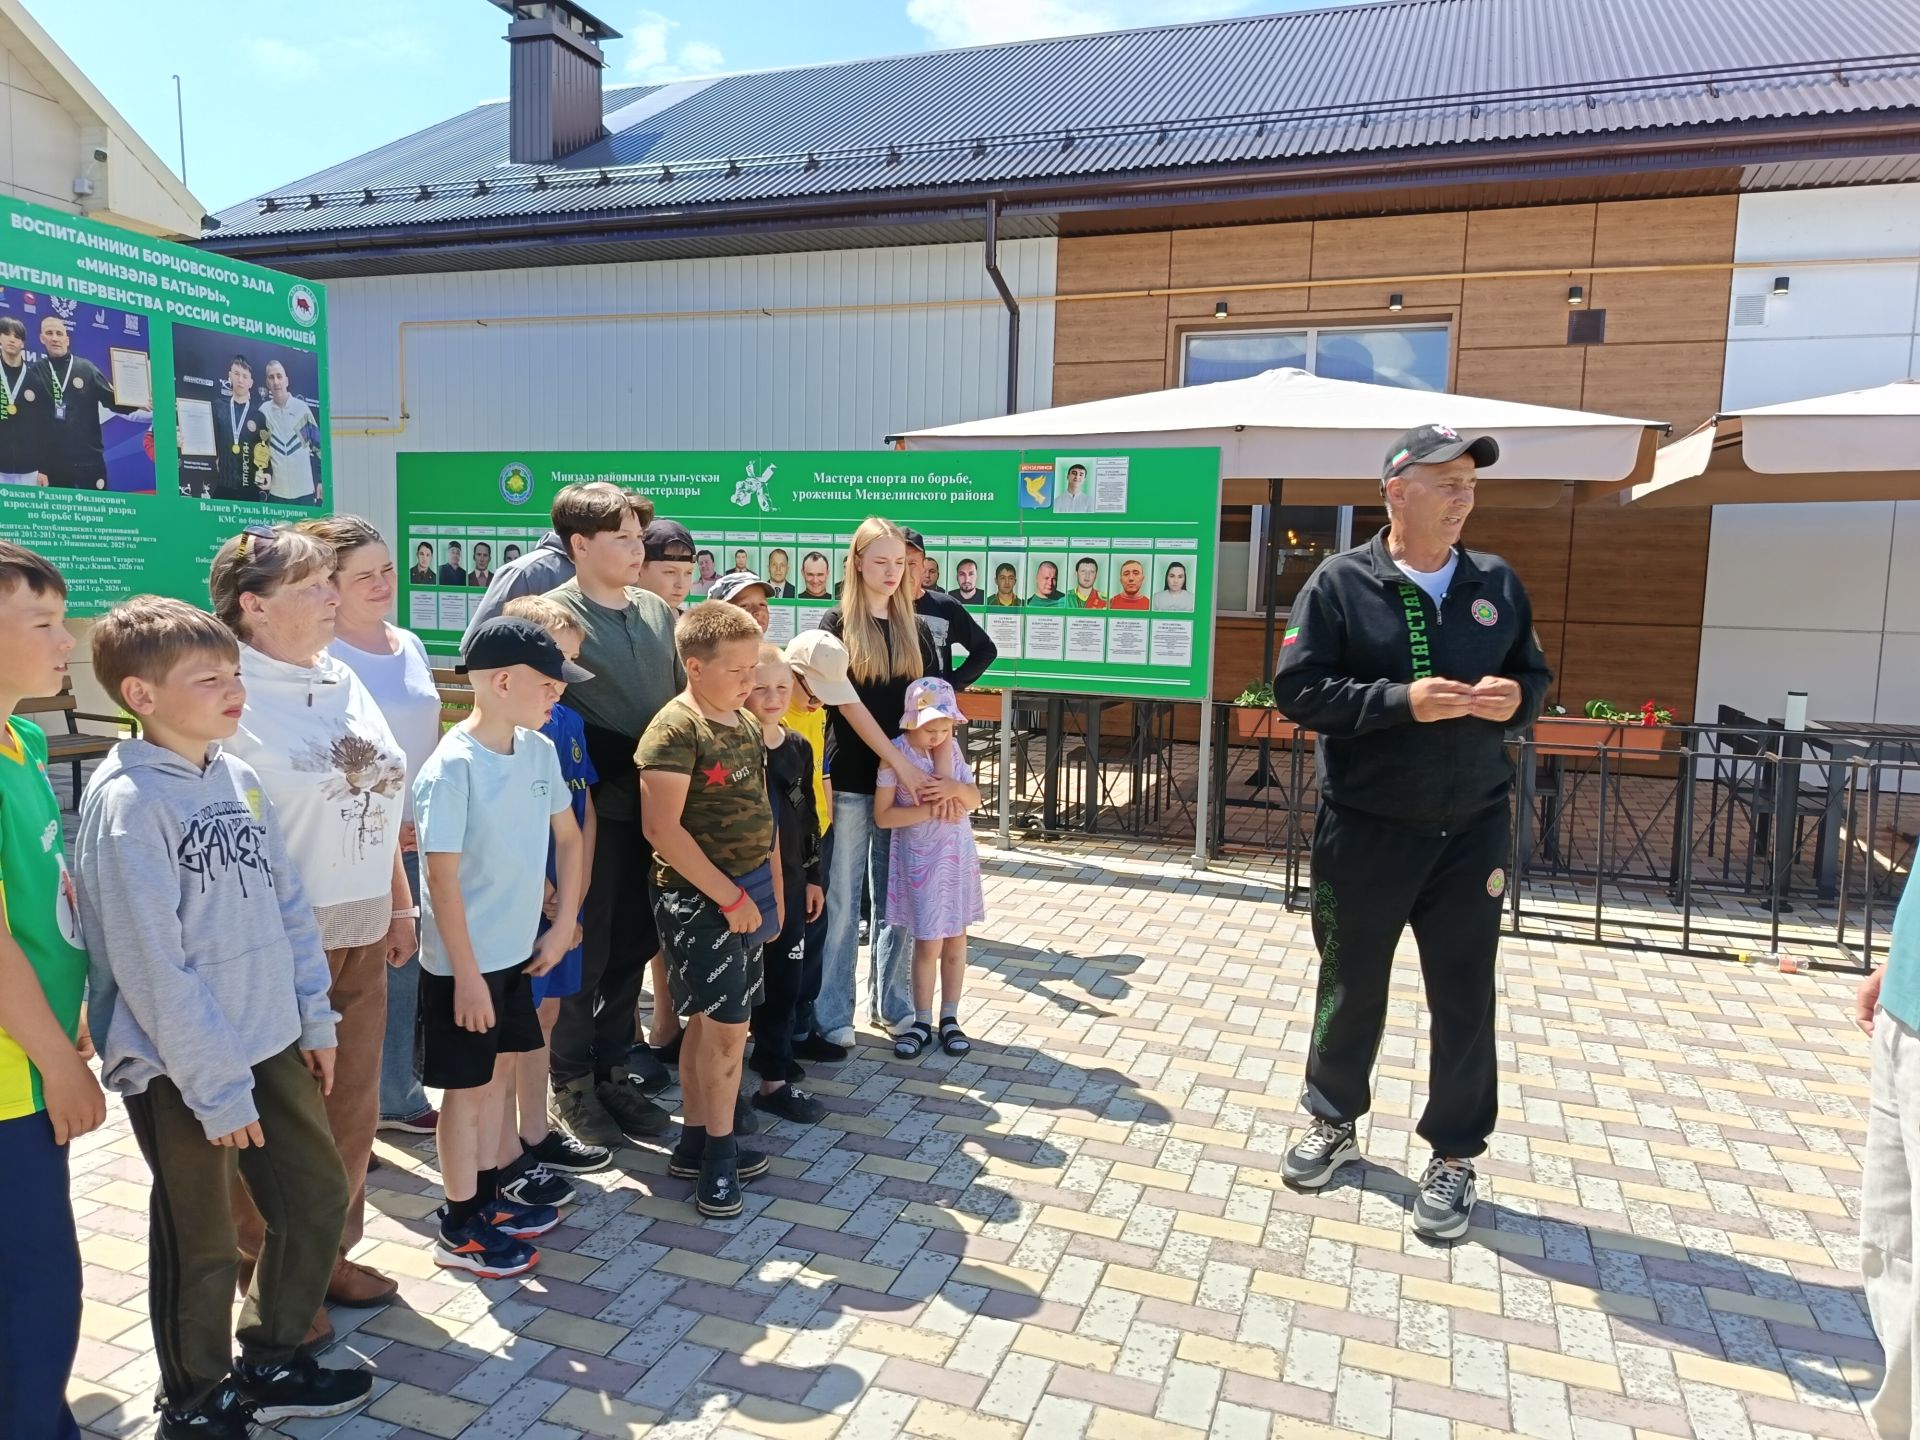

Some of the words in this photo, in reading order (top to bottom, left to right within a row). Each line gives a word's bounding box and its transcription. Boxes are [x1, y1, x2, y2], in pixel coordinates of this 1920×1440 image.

[11, 213, 139, 260] ВОСПИТАННИКИ
[143, 249, 239, 286] БОРЦОВСКОГО
[242, 275, 275, 295] ЗАЛА
[77, 257, 157, 287] «МИНЗӘЛӘ
[161, 276, 230, 307] БАТЫРЫ»,
[0, 262, 63, 289] ДИТЕЛИ
[67, 277, 163, 312] ПЕРВЕНСТВА
[166, 299, 220, 324] РОССИИ
[222, 313, 263, 333] СРЕДИ
[265, 323, 316, 345] ЮНОШЕЙ
[551, 471, 594, 482] Минзәлә
[597, 472, 656, 483] районында
[814, 472, 862, 486] Мастера
[867, 474, 907, 486] спорта
[910, 475, 924, 484] по
[928, 473, 972, 487] борьбе,
[0, 488, 36, 500] Факаев
[637, 487, 700, 498] мастерлары
[792, 490, 851, 502] уроженцы
[855, 488, 947, 501] Мензелинского
[950, 490, 994, 503] района
[3, 500, 49, 510] взрослый
[51, 503, 106, 513] спортивный
[108, 507, 136, 516] разряд
[200, 502, 231, 513] Валиев
[262, 506, 308, 519] Ильнурович
[41, 510, 72, 522] борьбе
[218, 515, 237, 524] КМС
[20, 530, 56, 539] 2012-2013
[1398, 582, 1433, 681] АТАРСТАН
[706, 961, 729, 984] adidas
